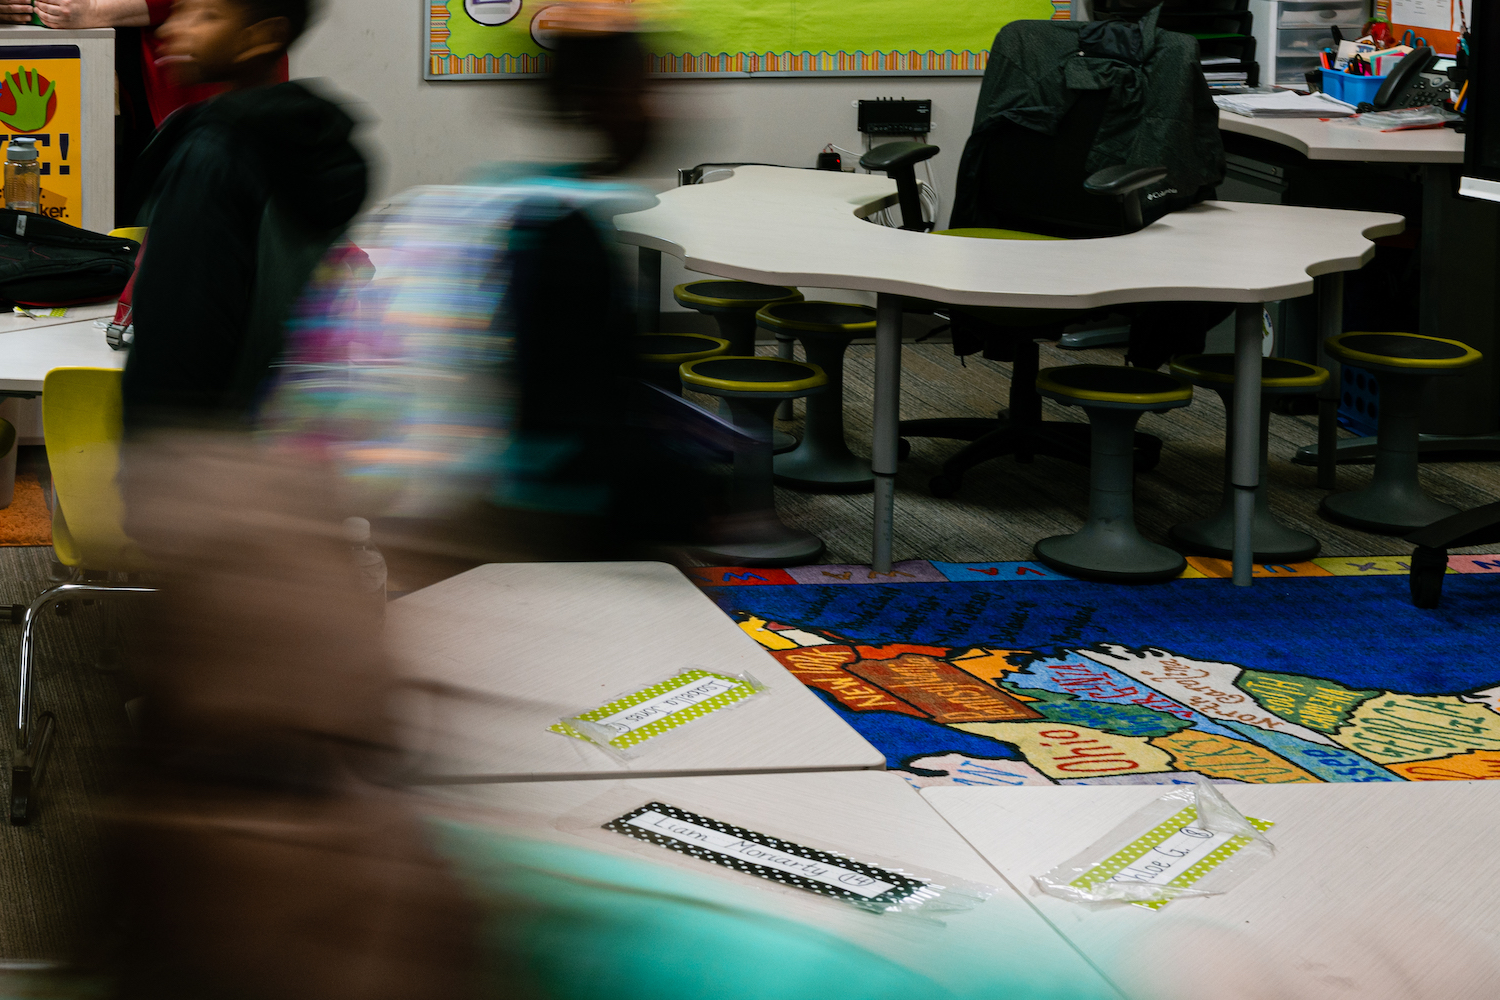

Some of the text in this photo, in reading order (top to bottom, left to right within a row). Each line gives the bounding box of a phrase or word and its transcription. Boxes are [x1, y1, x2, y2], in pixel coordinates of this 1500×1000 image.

[665, 680, 734, 706] Isabella
[812, 676, 897, 708] NEW
[1245, 675, 1306, 715] SOUTH
[1300, 686, 1361, 729] CAROLINA
[1353, 698, 1500, 758] GEORGIA
[1038, 728, 1139, 774] Ohio
[651, 815, 873, 886] Liam Moriarty 14
[1151, 844, 1192, 859] G.
